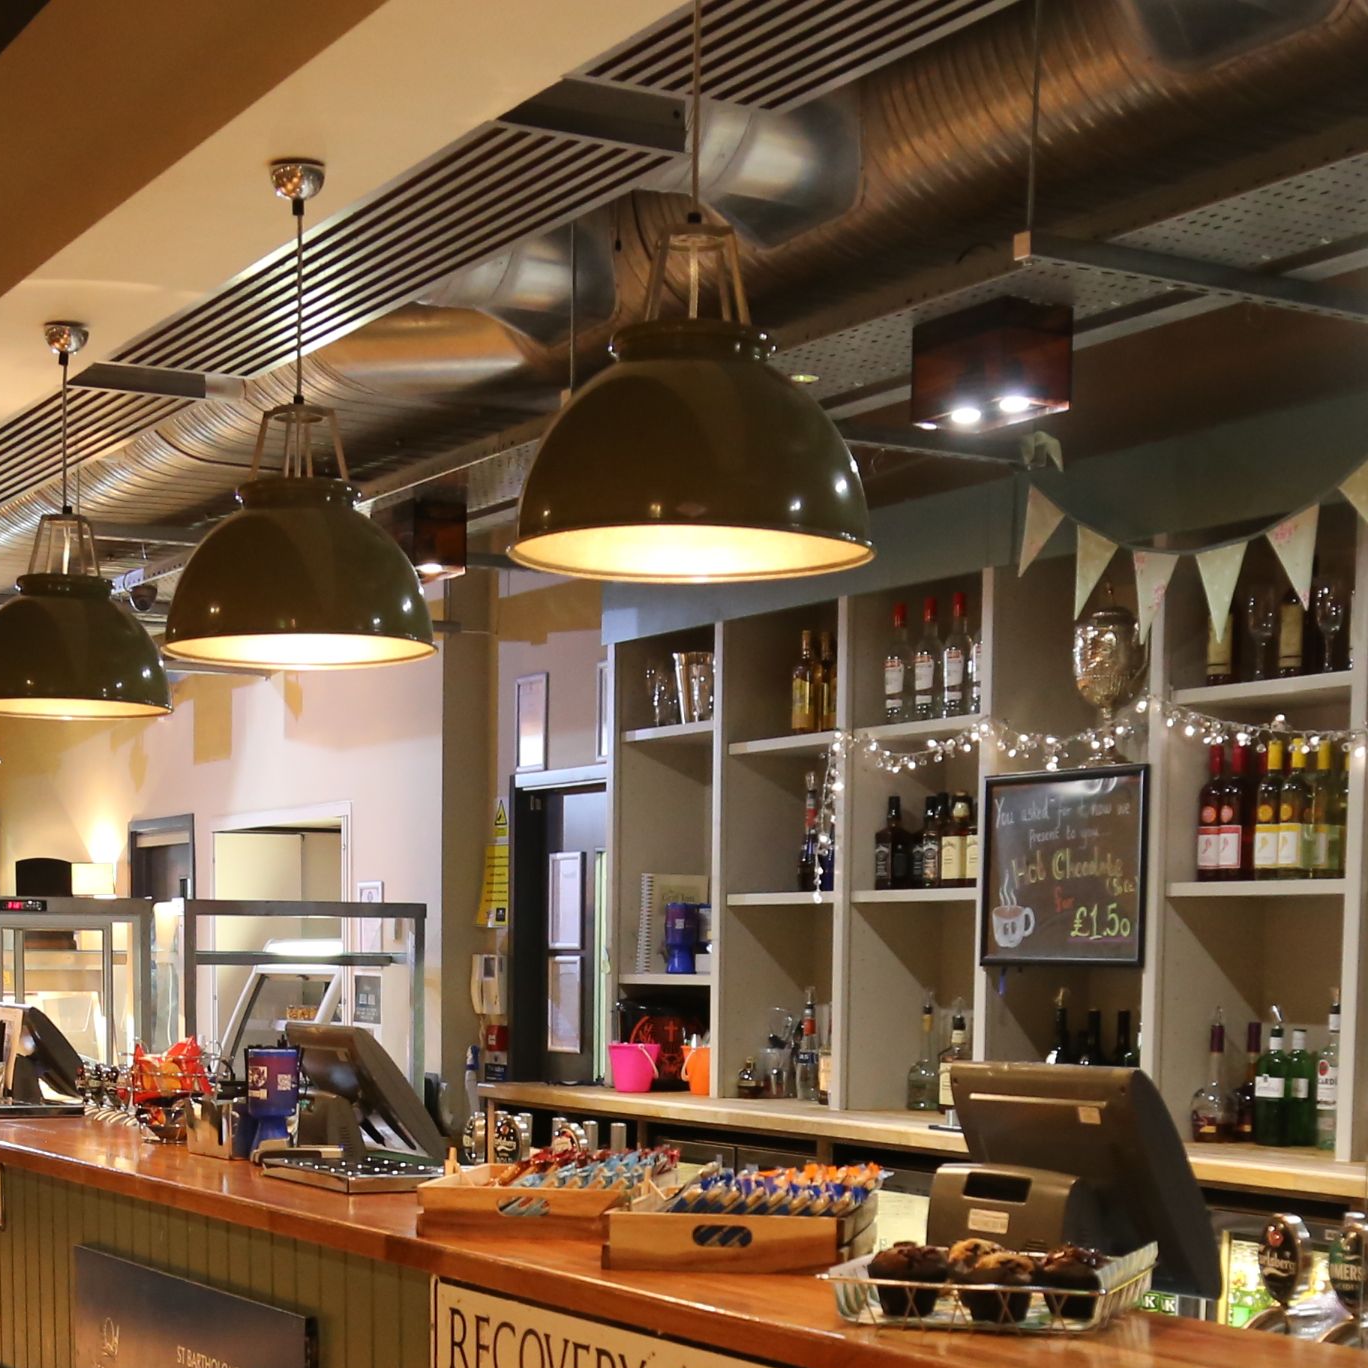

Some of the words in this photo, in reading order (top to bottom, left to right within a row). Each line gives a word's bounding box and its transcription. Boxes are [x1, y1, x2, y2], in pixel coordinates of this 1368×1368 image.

[994, 797, 1015, 829] You
[1021, 796, 1050, 822] asked
[1065, 824, 1076, 841] to
[1011, 850, 1047, 891] Hot
[1070, 903, 1131, 940] £1.50
[176, 1344, 186, 1365] ST
